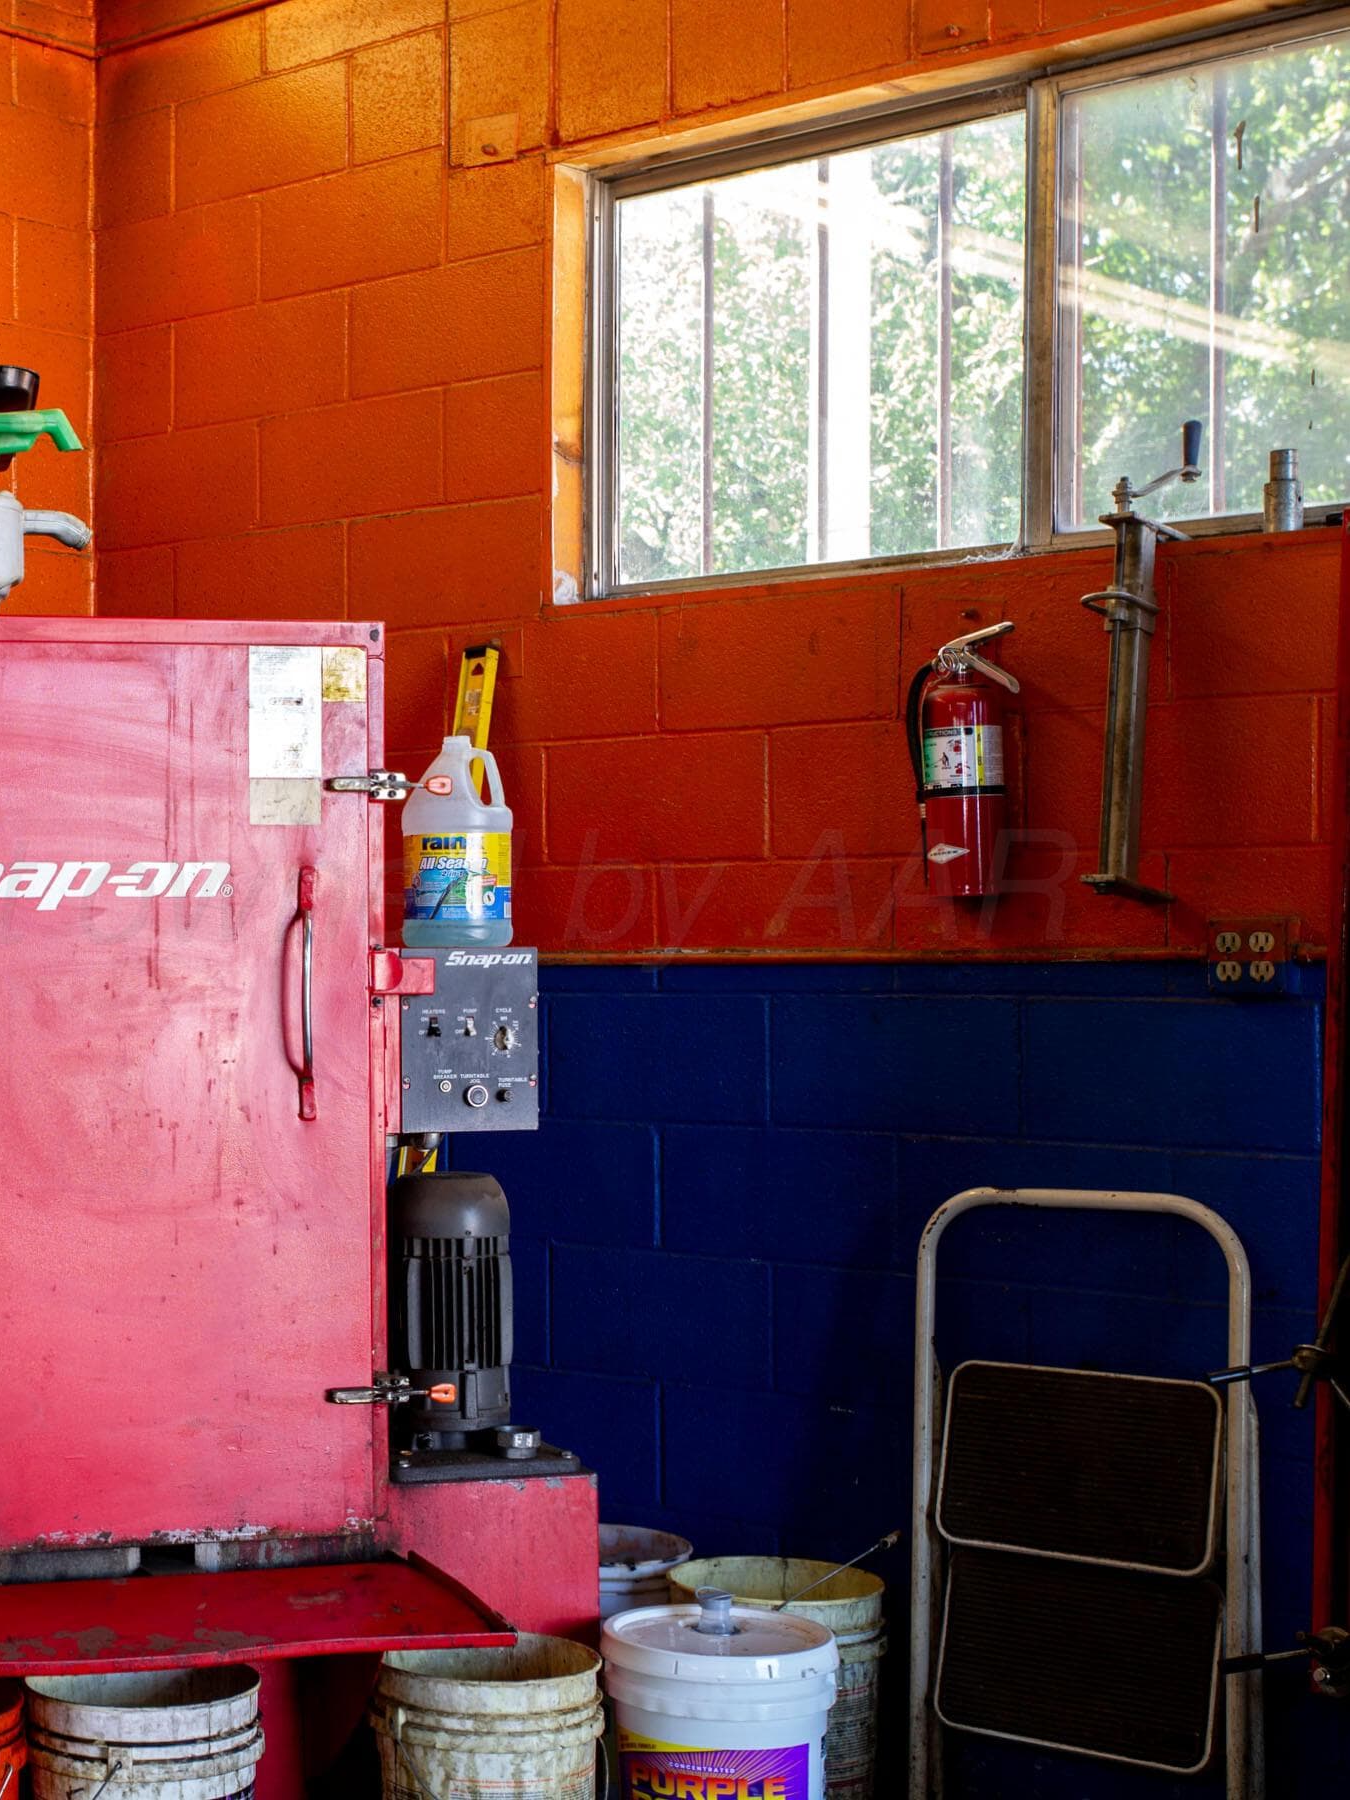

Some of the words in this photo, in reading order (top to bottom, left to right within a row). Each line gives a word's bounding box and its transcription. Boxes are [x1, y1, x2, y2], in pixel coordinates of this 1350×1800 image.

[419, 856, 436, 870] All
[437, 856, 488, 870] Sean
[445, 951, 532, 968] Snap-on
[668, 1760, 737, 1775] CONCENTRATED
[631, 1758, 787, 1800] PURPLE
